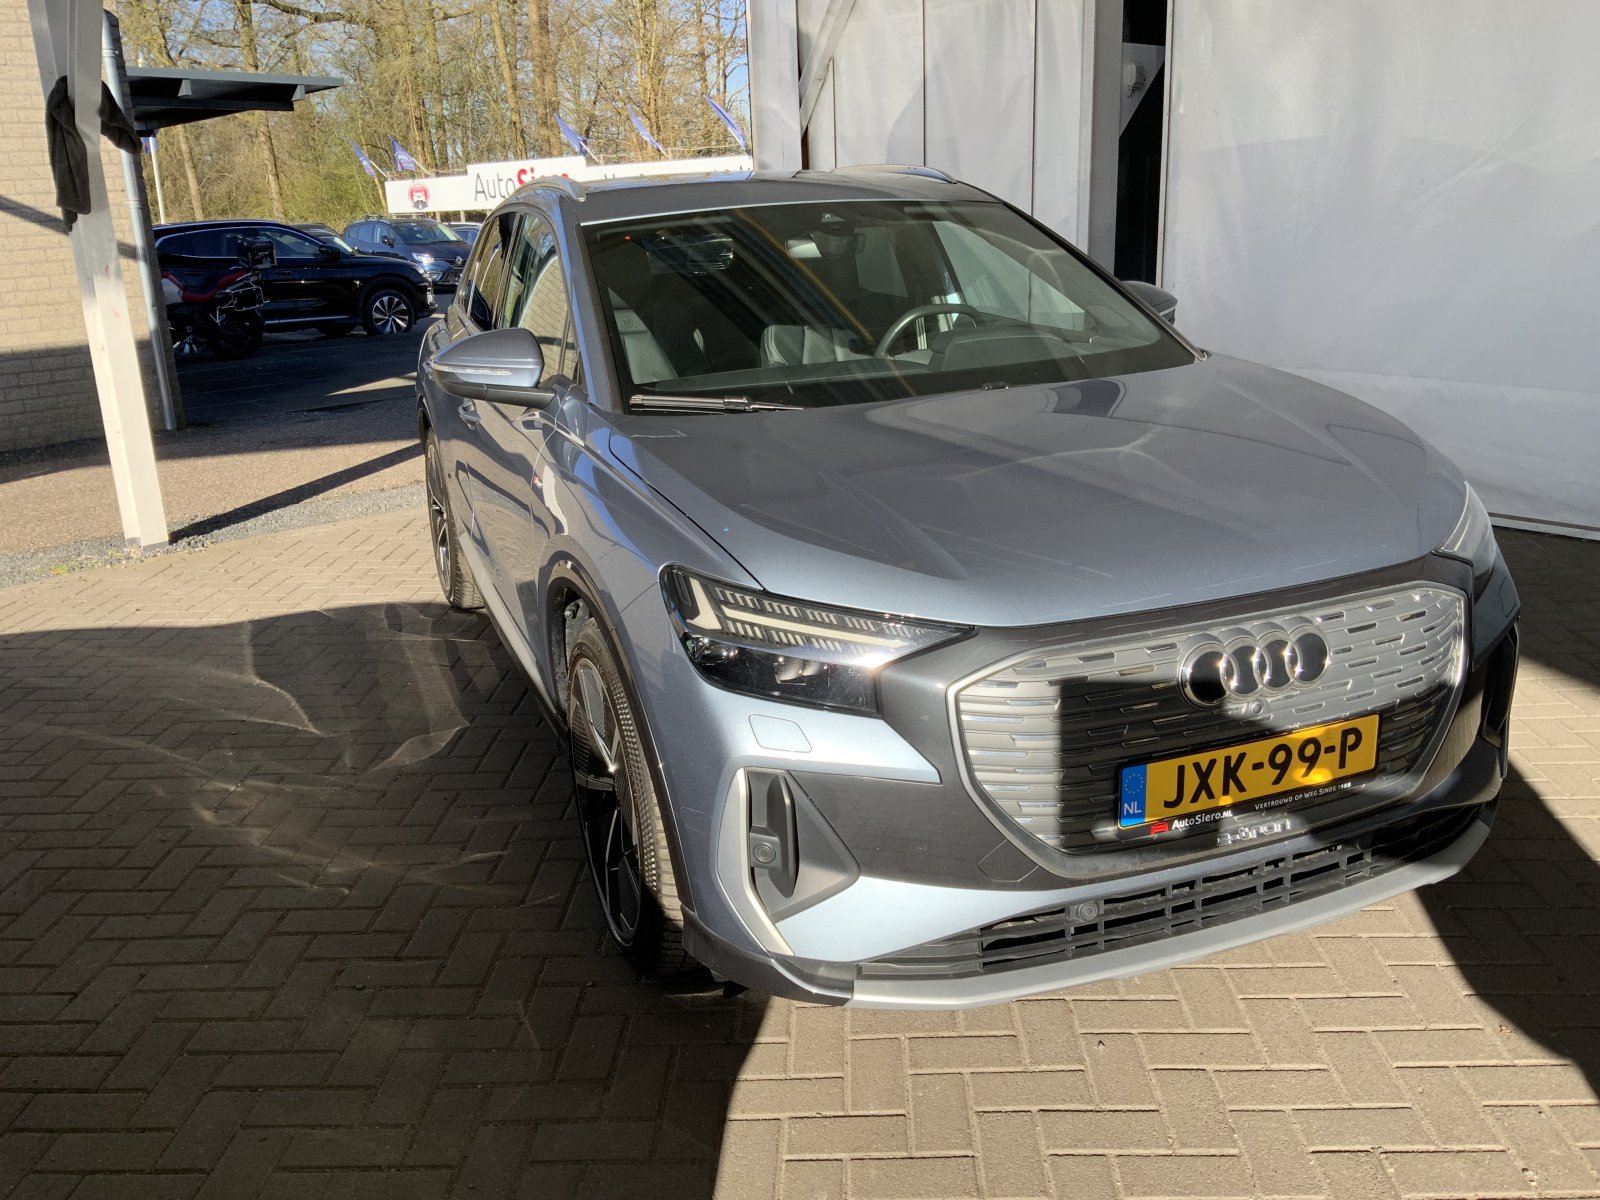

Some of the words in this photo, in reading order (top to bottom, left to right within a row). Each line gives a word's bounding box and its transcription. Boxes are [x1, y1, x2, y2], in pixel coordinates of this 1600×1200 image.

[1163, 727, 1363, 809] JXK-99-P
[1294, 793, 1304, 801] OP
[1123, 801, 1142, 815] NL
[1171, 810, 1233, 830] AutoSiero.NL
